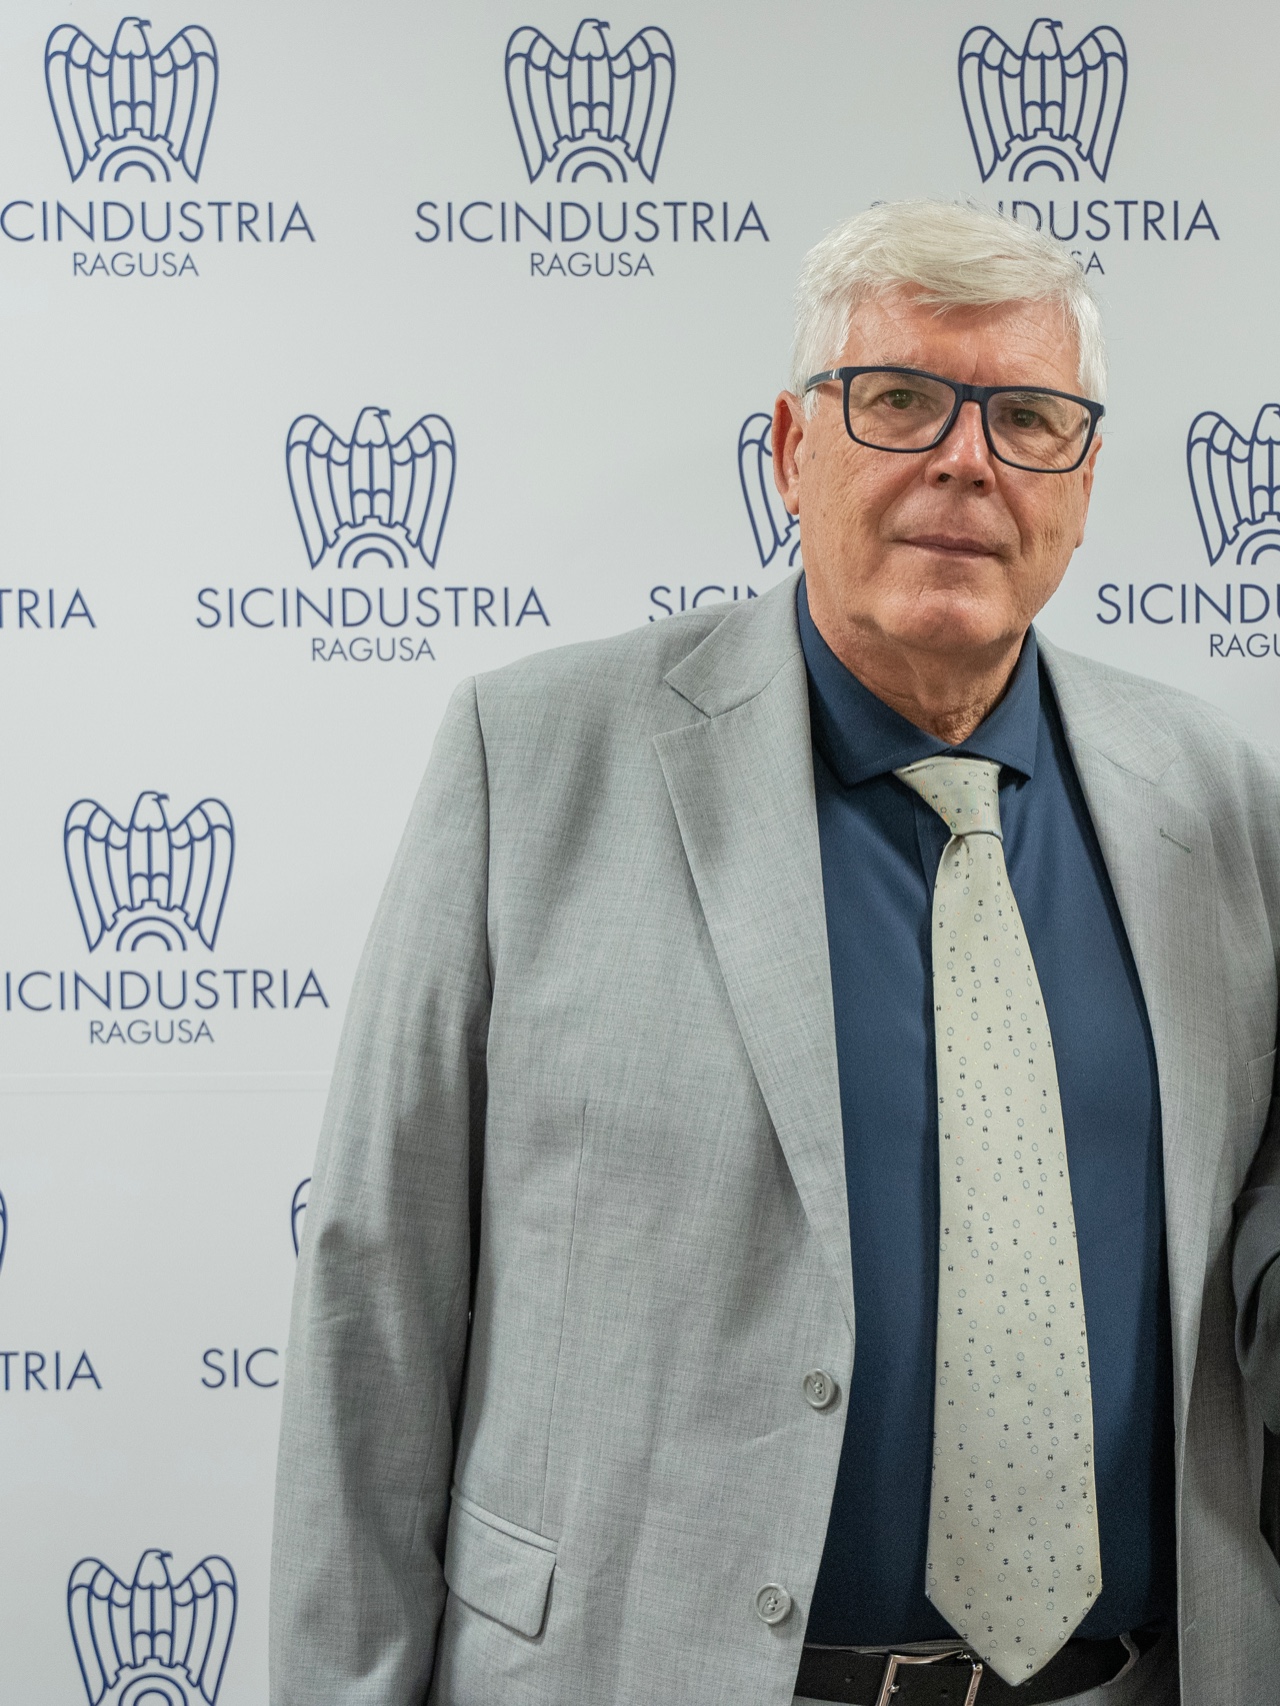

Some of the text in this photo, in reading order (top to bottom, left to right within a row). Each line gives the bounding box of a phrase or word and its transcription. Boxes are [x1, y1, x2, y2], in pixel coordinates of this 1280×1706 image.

[415, 201, 770, 242] SICINDUSTRIA
[74, 252, 199, 277] RAGUSA
[531, 252, 654, 276] RAGUSA
[197, 587, 550, 628] SICINDUSTRIA
[312, 637, 435, 661] RAGUSA
[90, 1019, 214, 1044] RAGUSA
